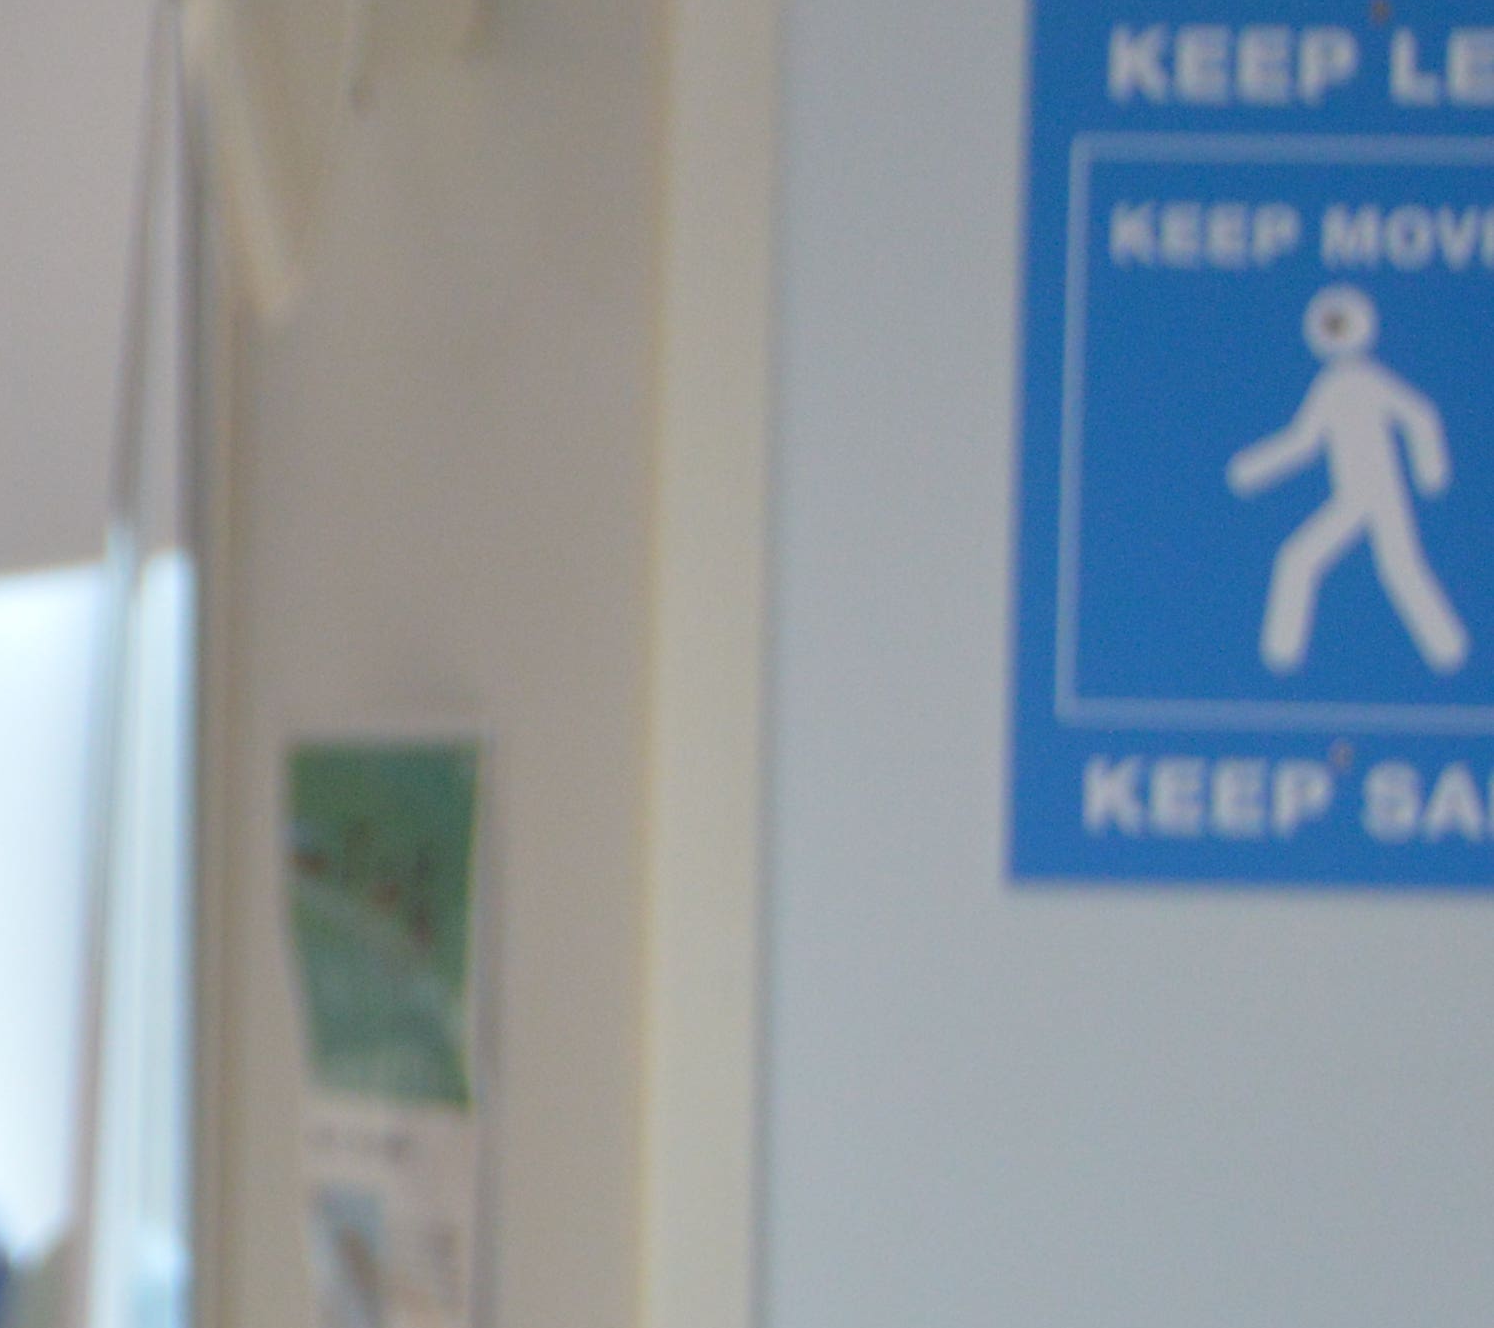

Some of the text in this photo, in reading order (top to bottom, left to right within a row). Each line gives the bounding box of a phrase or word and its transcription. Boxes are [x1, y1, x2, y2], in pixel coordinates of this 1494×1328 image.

[1109, 24, 1357, 106] KEEP
[1109, 201, 1494, 271] KEEP MOV
[1082, 754, 1494, 843] KEEP SA
